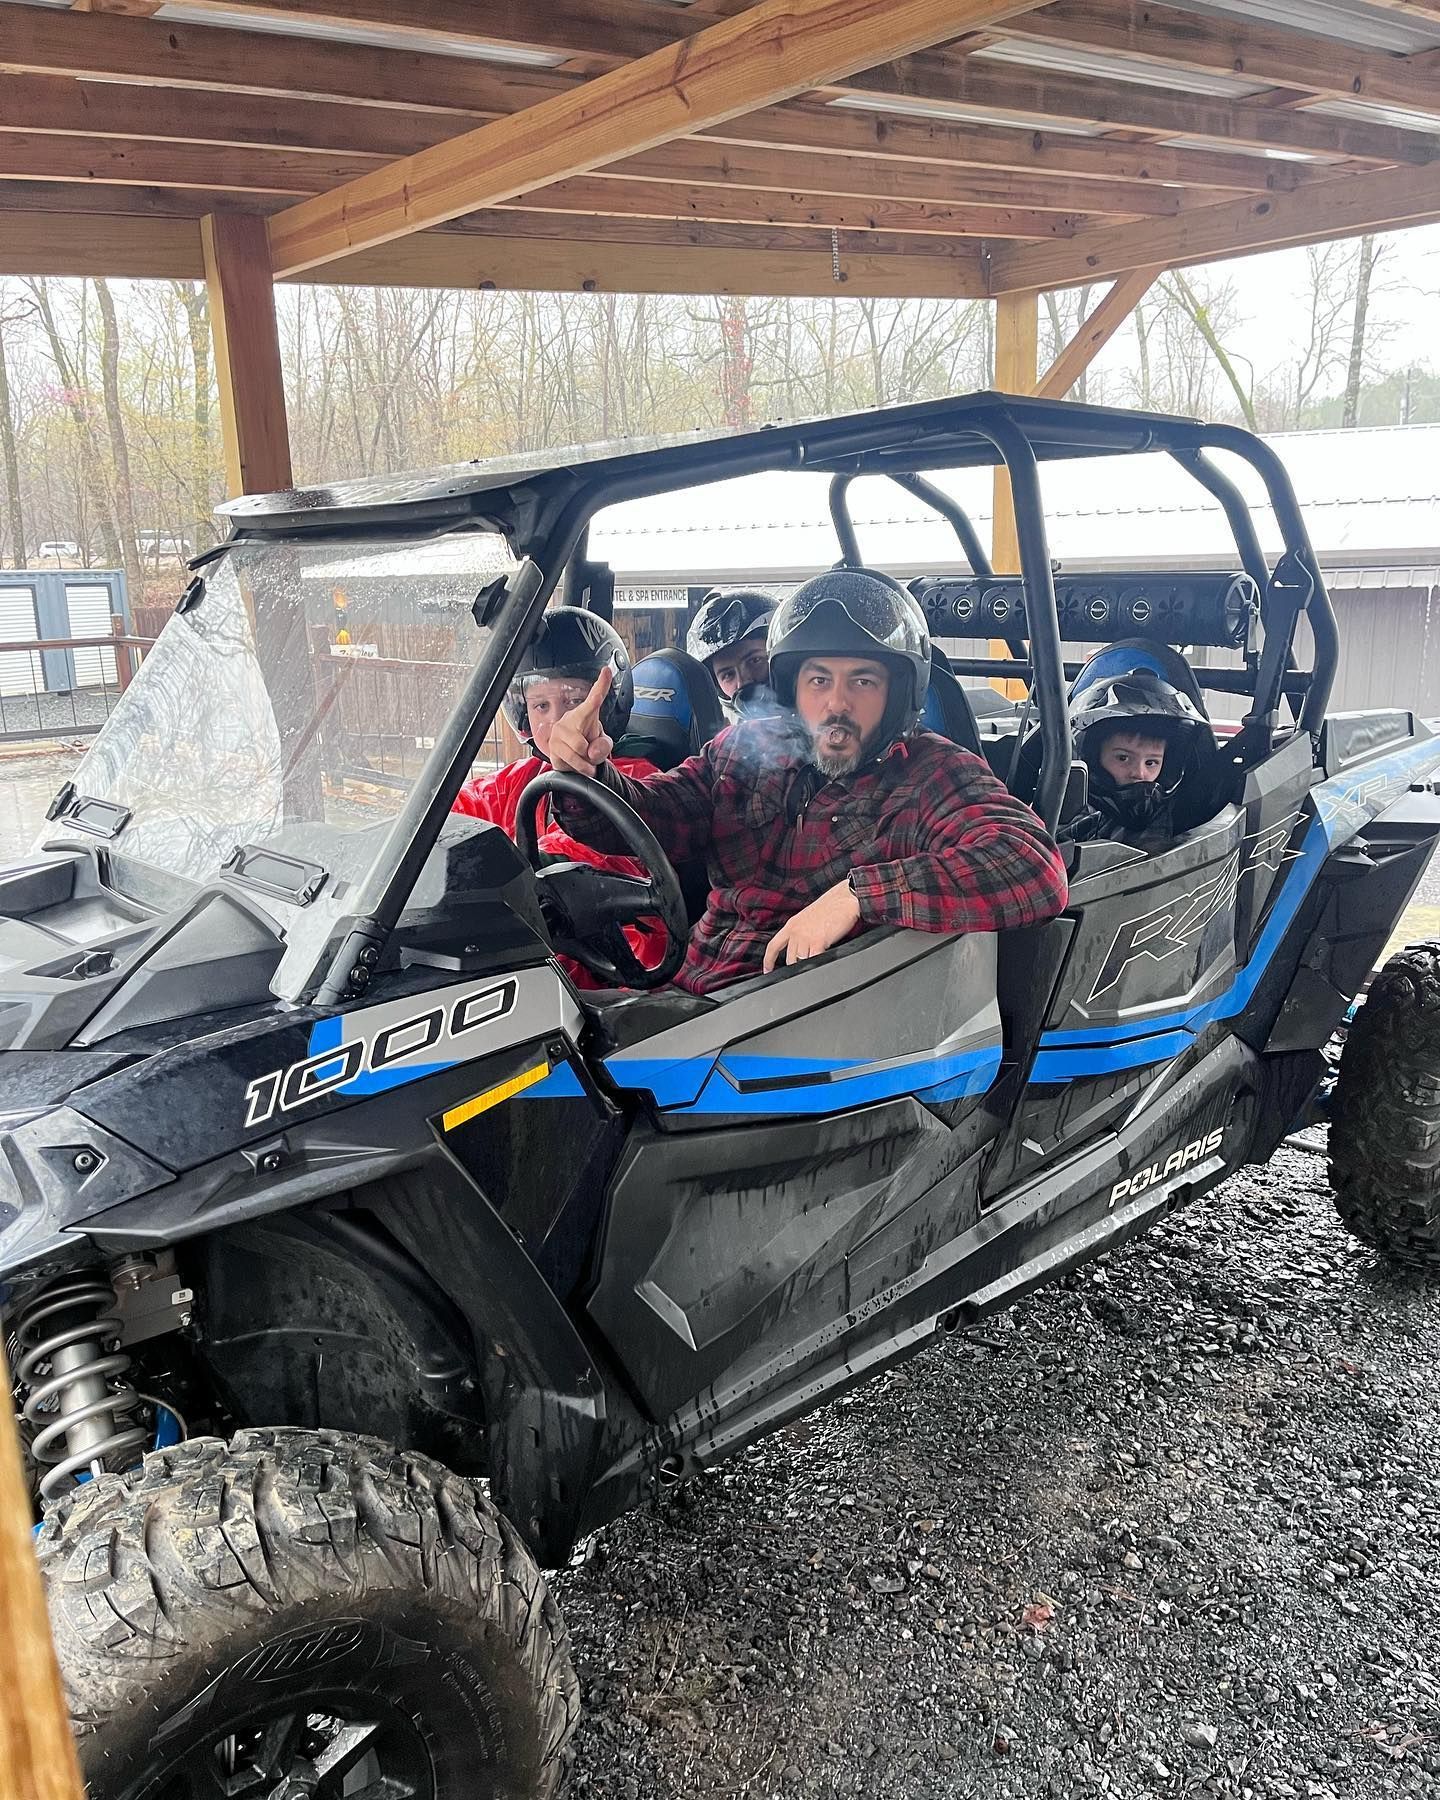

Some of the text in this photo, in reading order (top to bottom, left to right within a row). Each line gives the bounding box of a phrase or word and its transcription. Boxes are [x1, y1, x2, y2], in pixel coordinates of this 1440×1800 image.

[629, 590, 634, 601] &
[636, 590, 649, 601] SPA
[651, 589, 687, 601] ENTRANCE
[1317, 773, 1388, 826] XP
[1086, 811, 1310, 1004] RZR
[244, 975, 520, 1128] 1000
[1108, 1126, 1224, 1208] POLARIS
